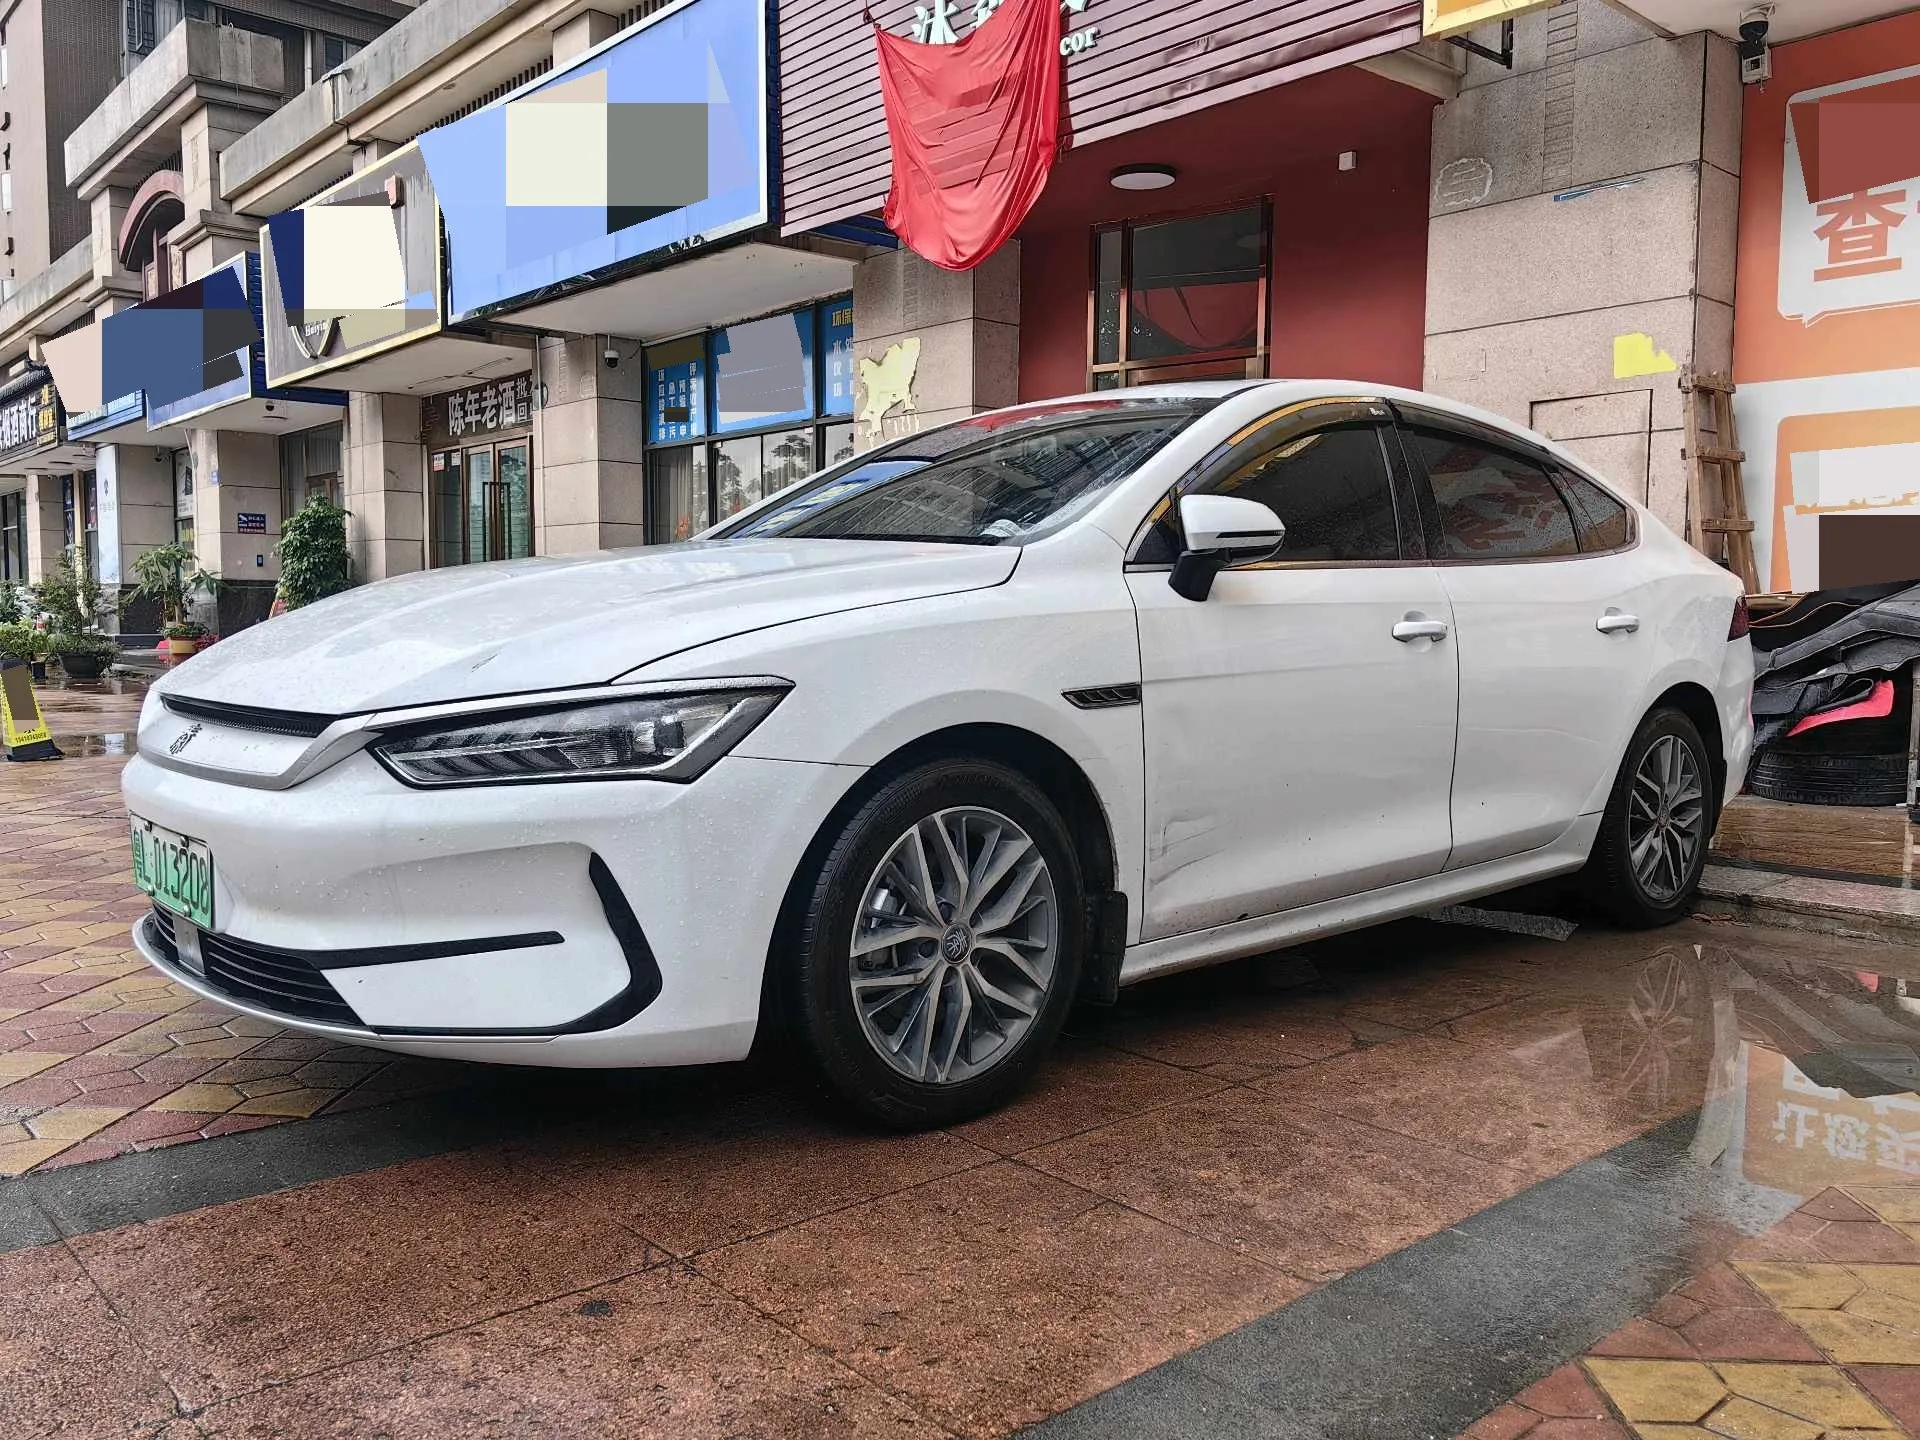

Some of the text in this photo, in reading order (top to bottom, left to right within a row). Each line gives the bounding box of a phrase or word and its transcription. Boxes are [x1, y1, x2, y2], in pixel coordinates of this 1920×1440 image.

[1813, 188, 1920, 283] 查
[0, 391, 37, 453] 烟酒商行
[448, 380, 516, 437] 陈年老酒
